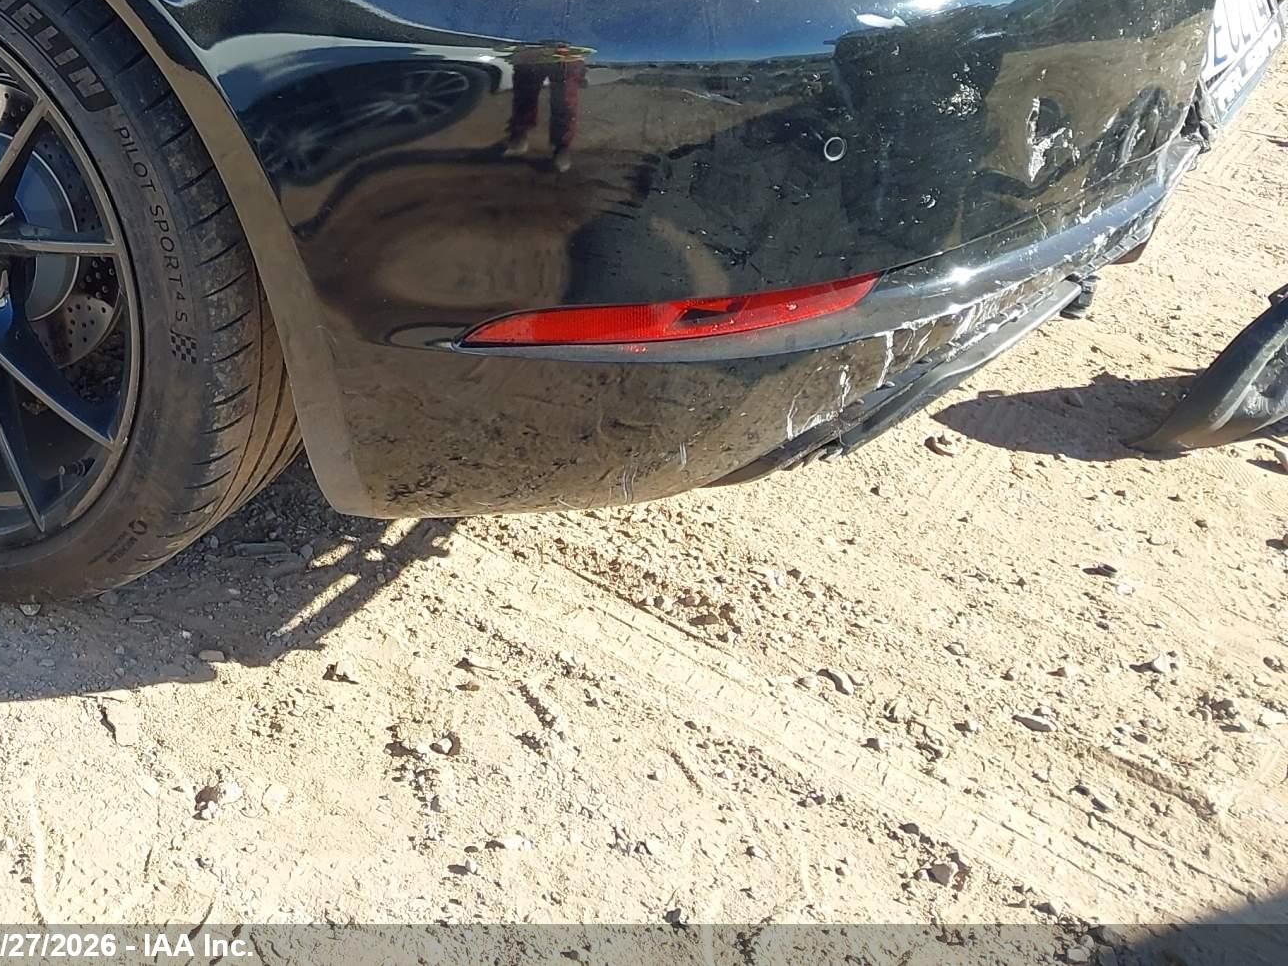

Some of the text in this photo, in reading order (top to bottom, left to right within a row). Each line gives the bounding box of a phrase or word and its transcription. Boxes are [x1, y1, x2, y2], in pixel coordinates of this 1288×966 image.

[114, 124, 157, 193] PILOT
[149, 204, 185, 287] SPORT
[175, 310, 188, 323] S
